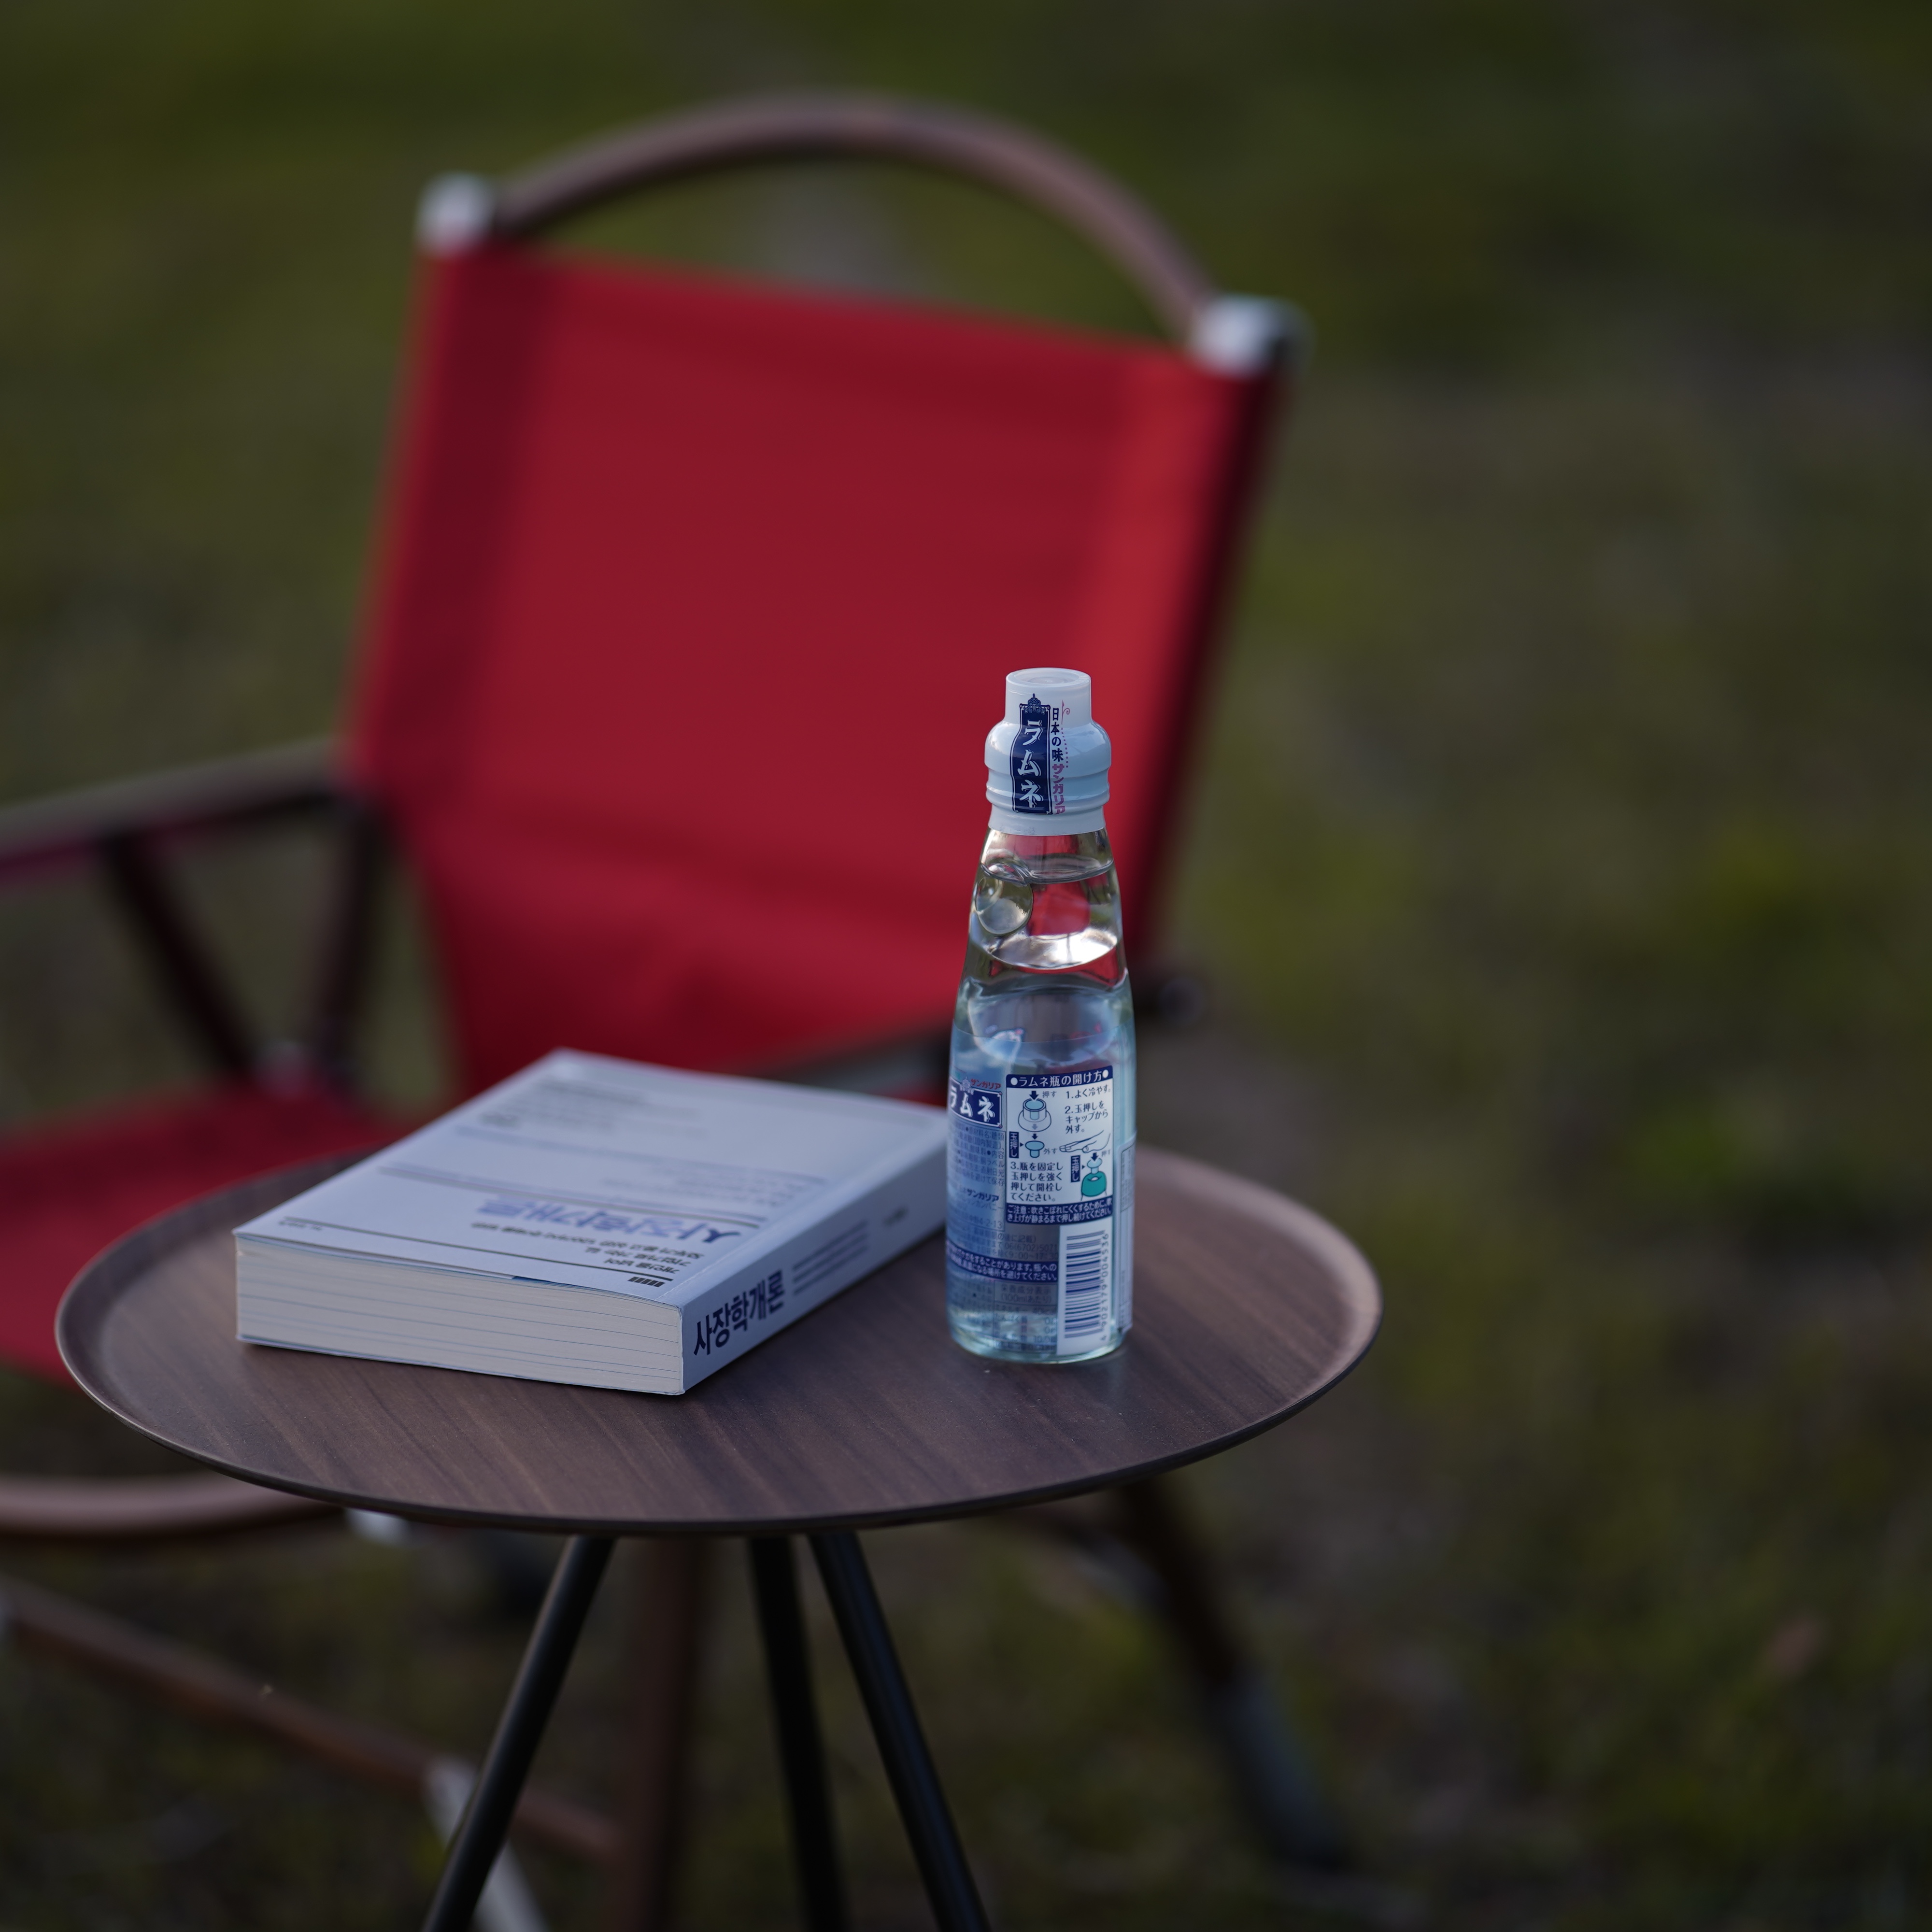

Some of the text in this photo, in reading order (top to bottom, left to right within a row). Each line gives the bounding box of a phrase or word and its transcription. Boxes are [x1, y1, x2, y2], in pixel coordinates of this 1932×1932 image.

[1017, 720, 1044, 809] ラムネ
[1051, 708, 1065, 815] 日本の味 サンガリア
[1065, 1109, 1108, 1124] キャップから
[1065, 1124, 1084, 1134] 外す。
[1011, 1172, 1062, 1181] 玉押しを強く
[1011, 1182, 1062, 1192] 押して開栓し
[1010, 1192, 1056, 1202] てください。
[694, 1269, 785, 1355] 사장학개론
